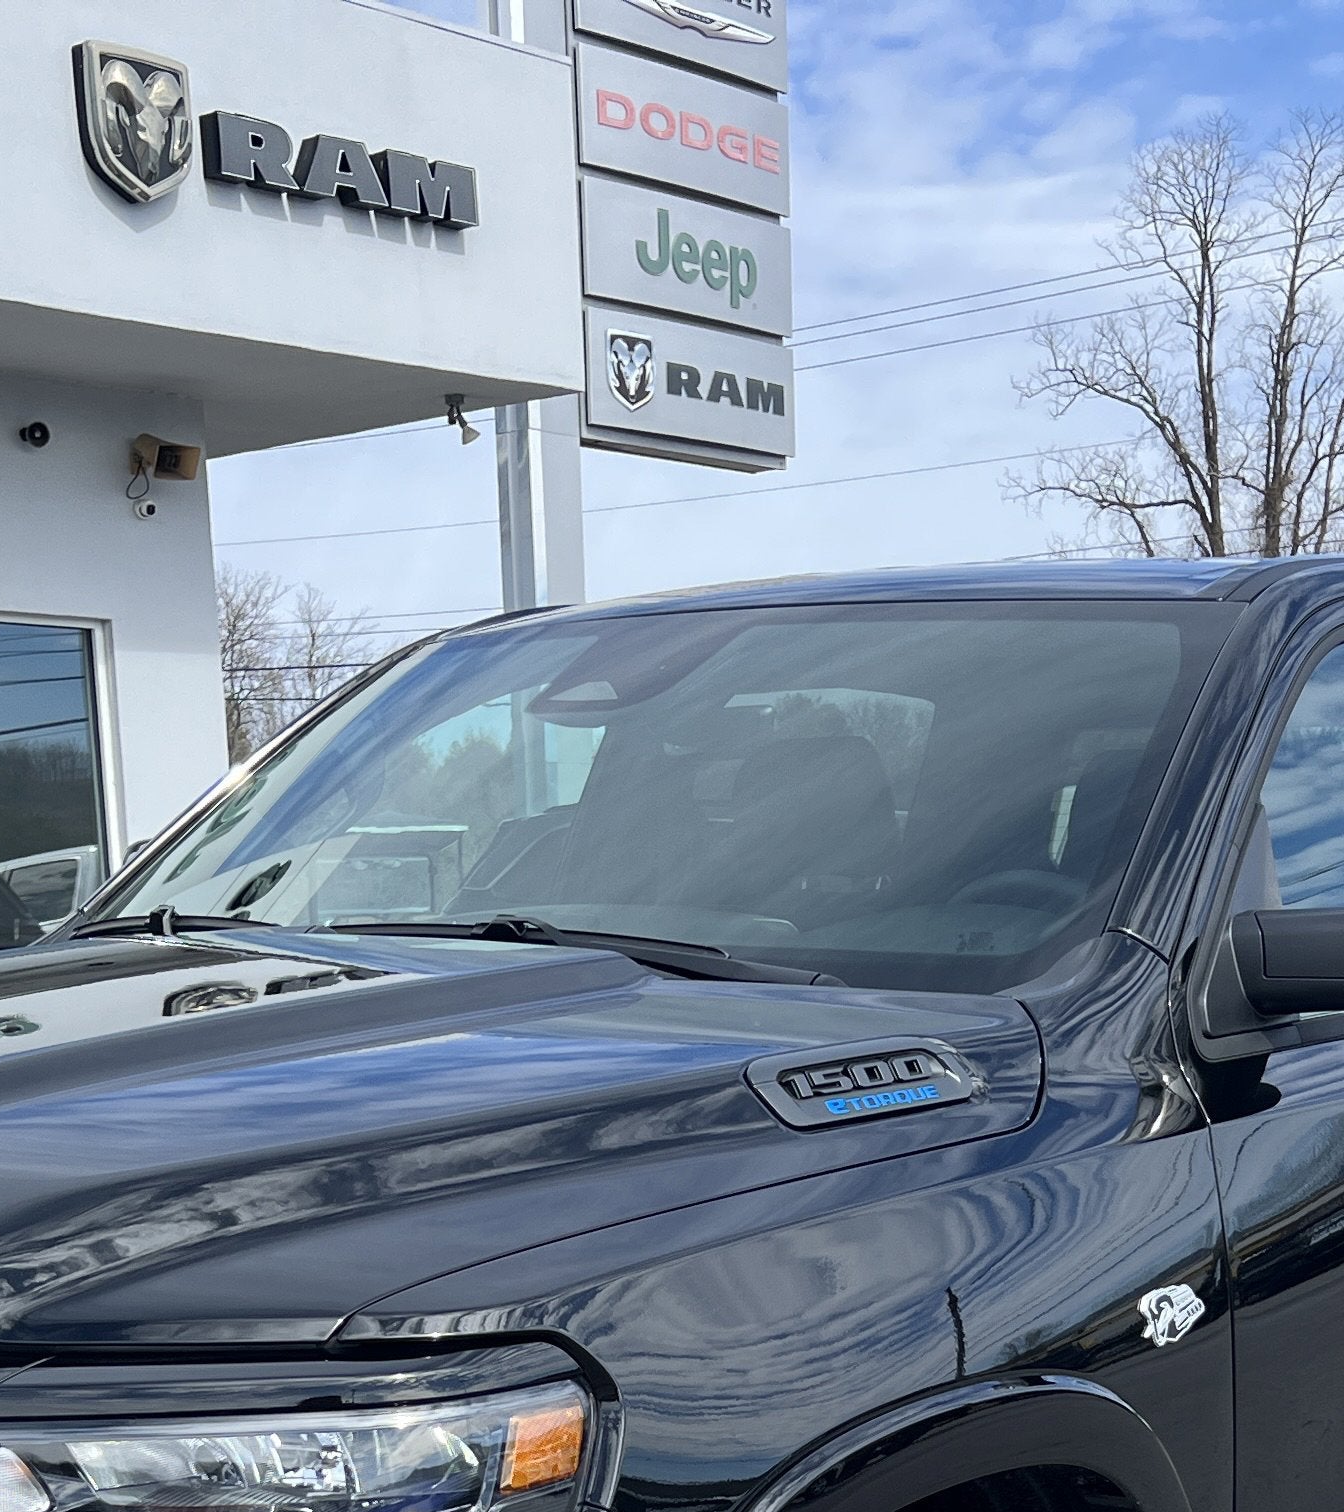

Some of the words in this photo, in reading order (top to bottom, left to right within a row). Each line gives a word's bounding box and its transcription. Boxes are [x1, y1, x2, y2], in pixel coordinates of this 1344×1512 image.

[203, 110, 480, 229] RAM
[596, 88, 780, 175] DODGE
[635, 207, 757, 308] Jeep
[666, 361, 785, 417] RAM
[783, 1055, 932, 1099] 1500
